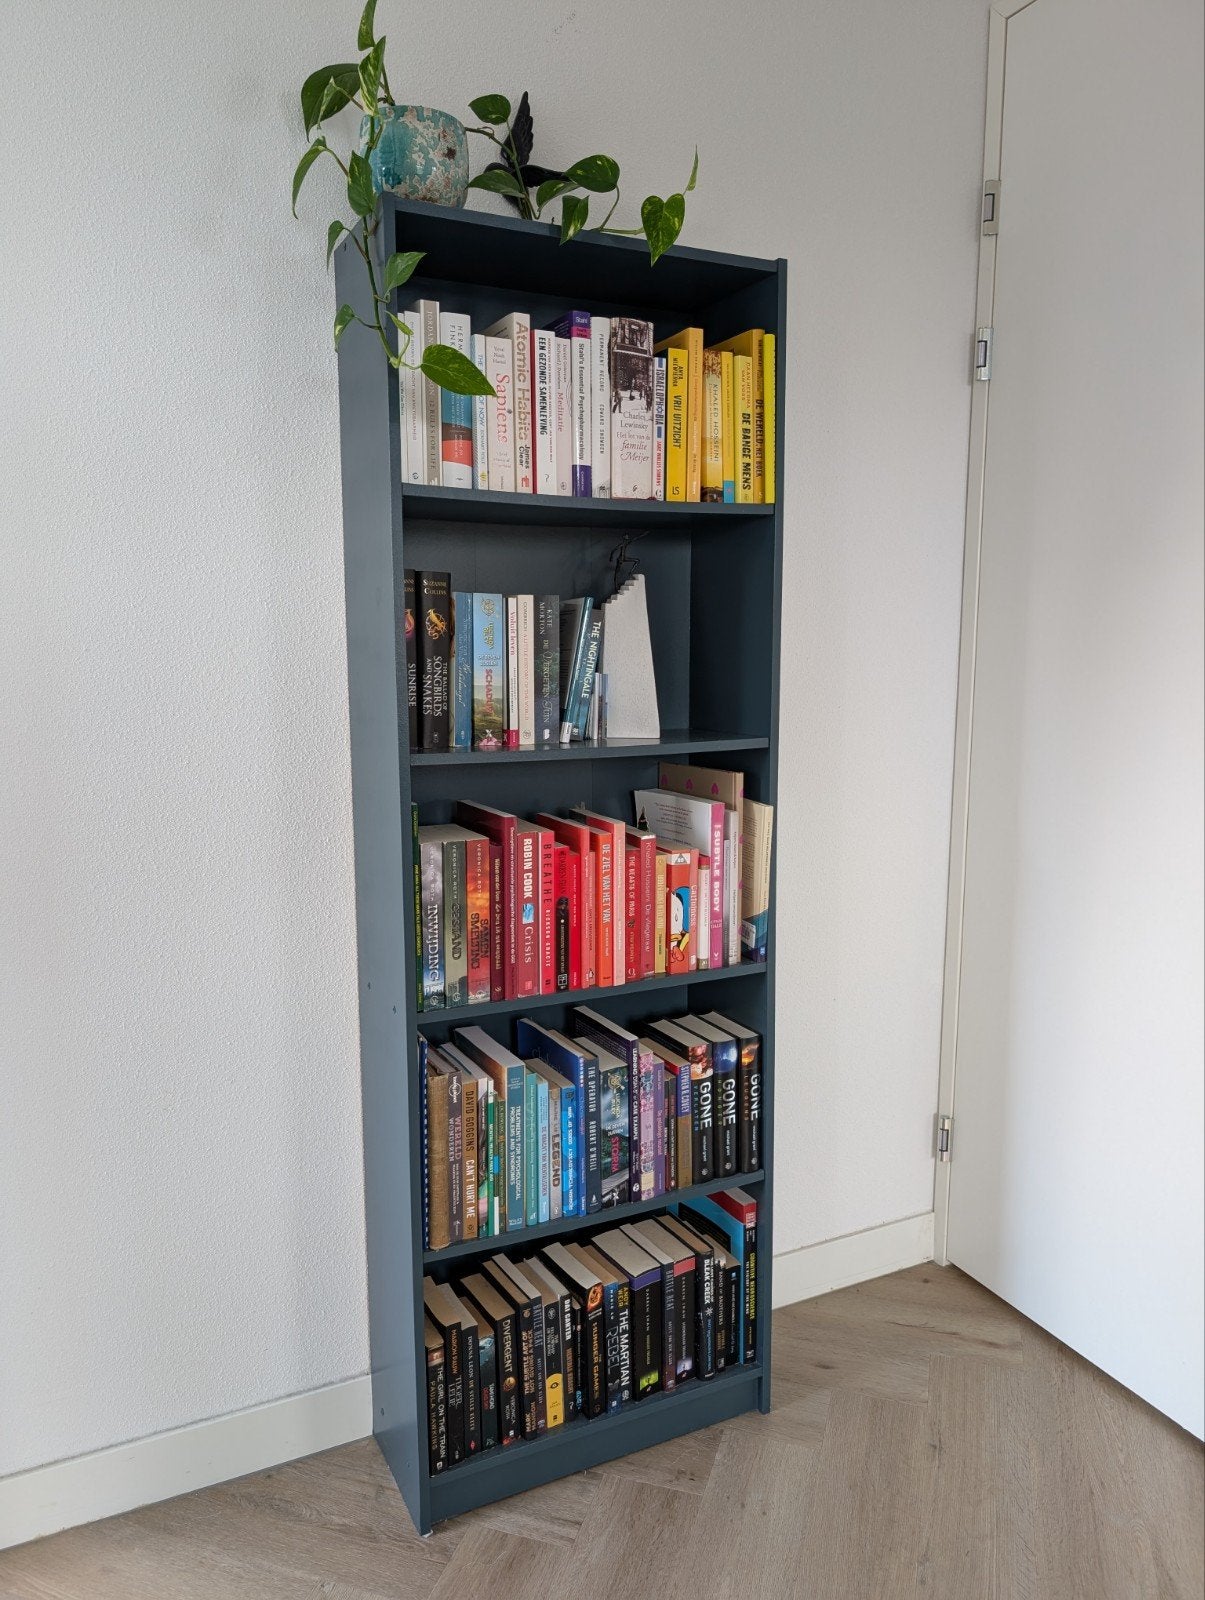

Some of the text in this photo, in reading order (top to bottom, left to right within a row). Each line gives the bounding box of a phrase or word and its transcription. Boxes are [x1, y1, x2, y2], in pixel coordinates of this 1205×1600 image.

[578, 343, 586, 365] Stahl's
[478, 396, 485, 405] OF
[516, 322, 531, 441] Atomic Habits
[538, 337, 548, 436] EEN GEZONDE SAMENLEVING
[578, 366, 586, 394] Essential
[429, 410, 437, 434] RULES
[494, 372, 511, 443] Sapiens
[557, 392, 566, 433] Meditatie
[578, 396, 586, 461] Psychopharmacology
[620, 421, 649, 431] Lewinsky
[672, 395, 682, 449] VRIJ UITZICHT
[619, 452, 652, 465] Meijer
[620, 440, 648, 452] familie
[742, 412, 751, 490] DE BANGE MENS
[755, 399, 764, 478] DE HET BOEK
[424, 588, 447, 596] COLLINS
[542, 651, 554, 698] VERGETEN
[581, 622, 602, 699] THE NIGHTINGALE
[408, 663, 417, 707] SUNRISE
[422, 674, 433, 715] SNAKES
[433, 655, 443, 717] SONGBIRDS
[443, 702, 448, 711] OF
[523, 838, 533, 899] ROBIN COOK
[602, 844, 611, 856] DE
[602, 856, 611, 874] ZIEL
[543, 844, 552, 904] BREATHE
[602, 875, 611, 891] VAN
[628, 856, 636, 917] THE BEASTS OF PARIS
[602, 892, 611, 907] HET
[602, 908, 611, 924] VAK
[690, 884, 698, 928] Catfulness
[713, 881, 721, 913] BODY
[426, 904, 439, 982] INWIJDING
[471, 913, 480, 970] SMELTING
[480, 919, 489, 959] SAMEN
[524, 926, 534, 964] Crisis
[681, 1065, 690, 1114] STEPHEN COVEY
[699, 1081, 712, 1130] GONE
[722, 1078, 736, 1127] GONE
[751, 1074, 761, 1121] GONE
[588, 1067, 597, 1172] THE OPERATOR ROBERT O'NEILL
[466, 1091, 475, 1219] DAVID GOGGINS CAN'T HURT ME
[552, 1134, 560, 1188] LEGEND
[611, 1136, 619, 1172] STORM
[666, 1270, 674, 1293] BATTLE
[522, 1331, 528, 1341] OF
[532, 1304, 542, 1329] BATTLE
[610, 1312, 614, 1320] LU
[502, 1319, 513, 1373] DIVERGENT
[606, 1326, 619, 1375] REBEL
[619, 1308, 630, 1387] THE MARTIAN
[438, 1404, 445, 1416] ON
